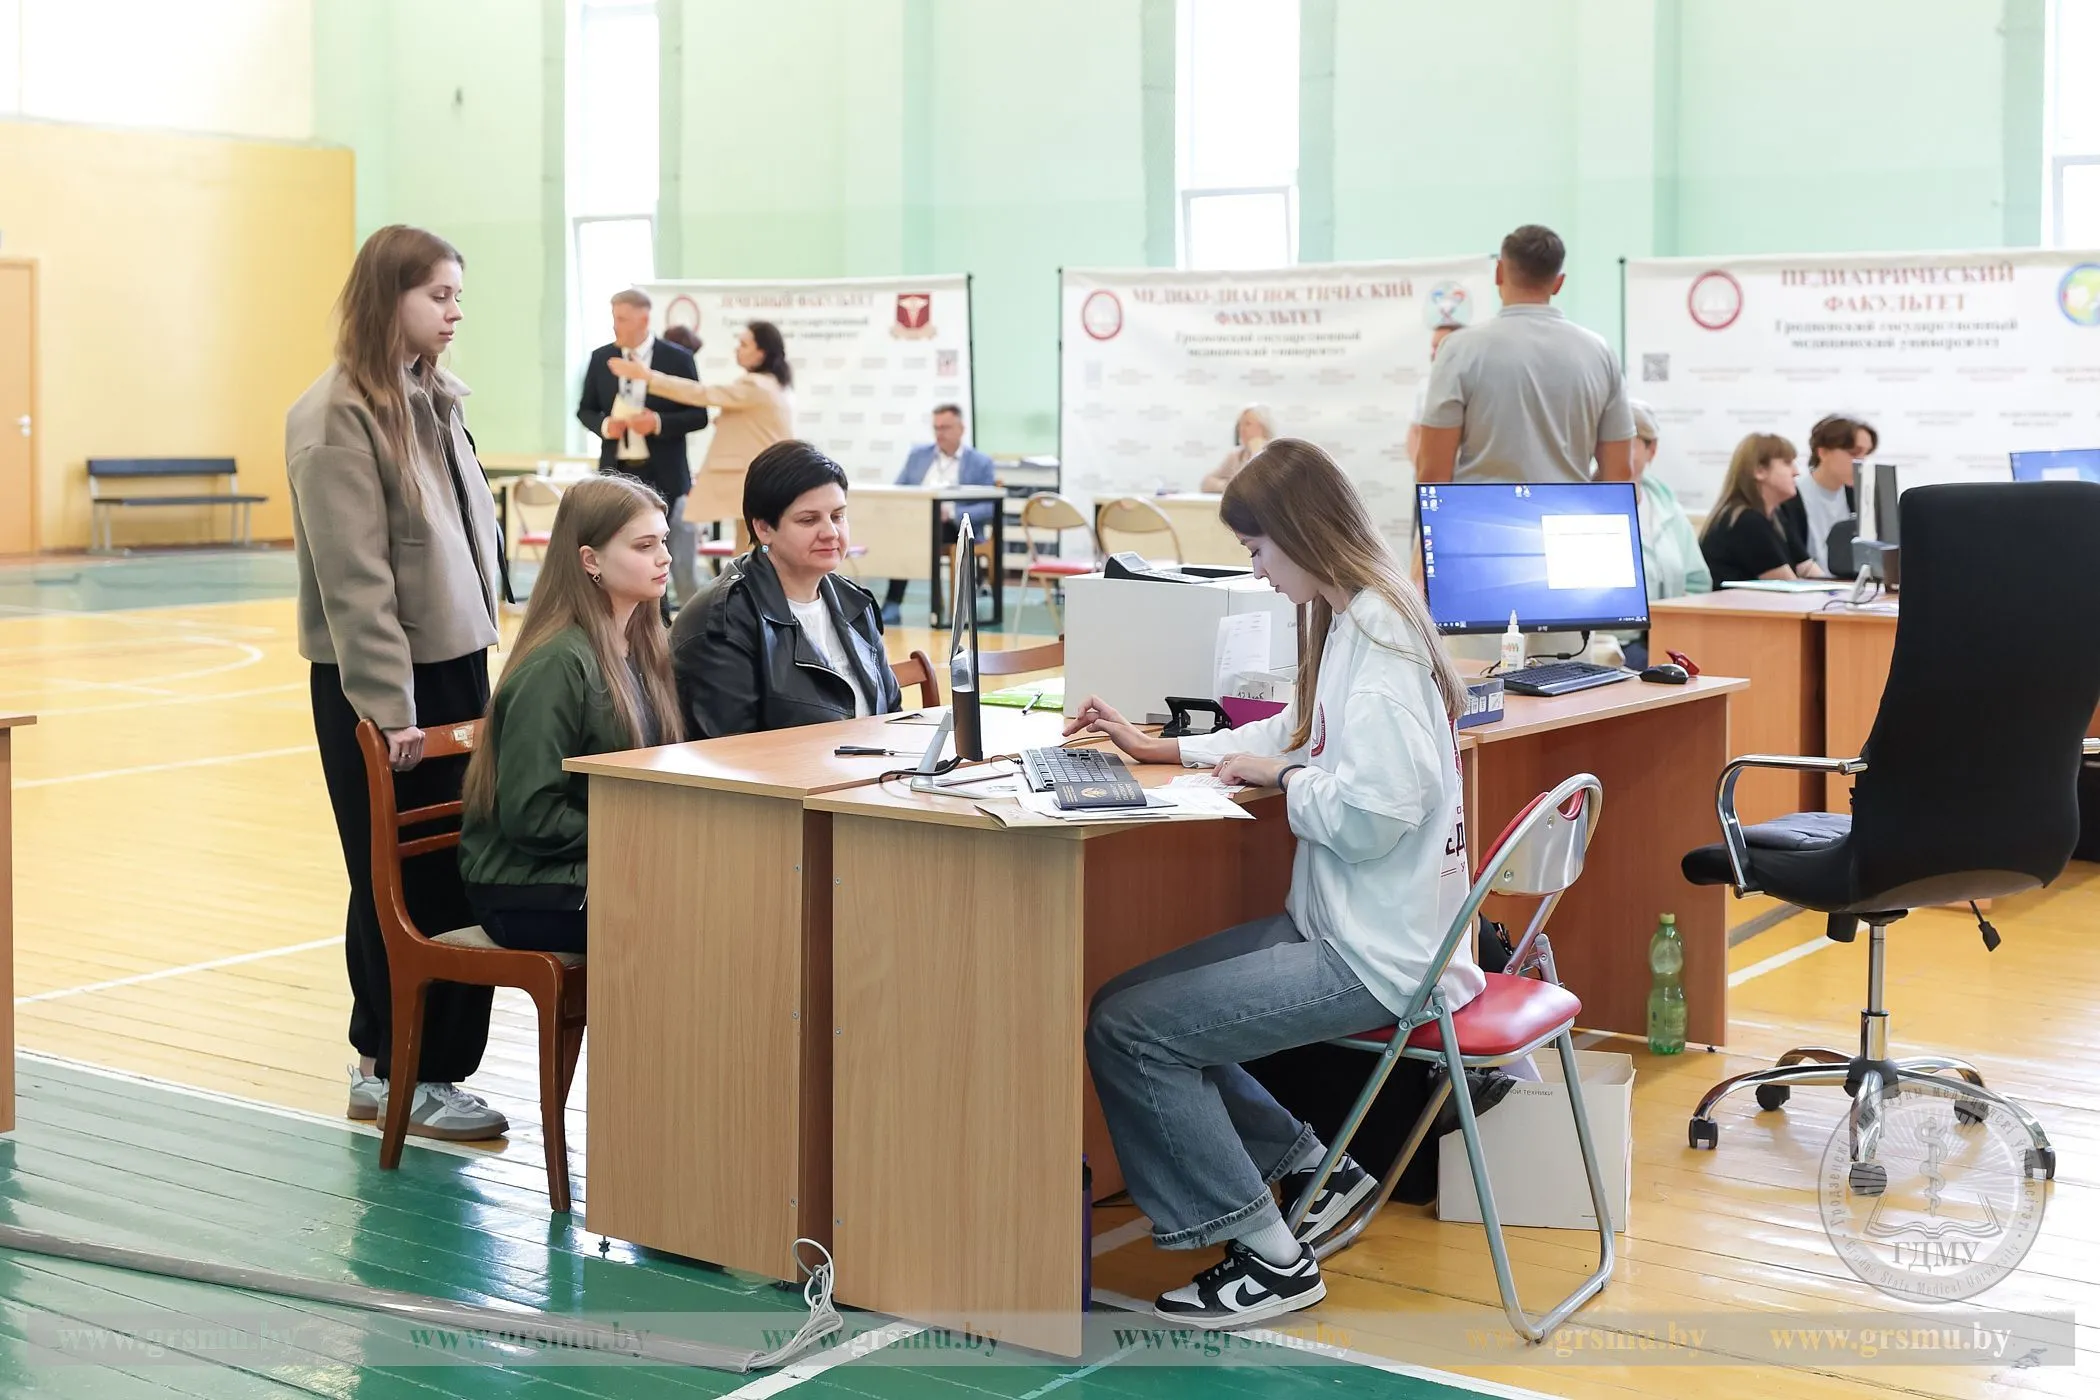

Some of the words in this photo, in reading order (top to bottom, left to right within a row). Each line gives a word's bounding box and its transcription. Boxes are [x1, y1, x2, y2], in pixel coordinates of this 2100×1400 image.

[1780, 264, 2015, 286] ПЕДИАТРИЧЕСКИЙ
[1824, 294, 1965, 312] ФАКУЛЬТЕТ
[1214, 309, 1323, 325] ФАКУЛЬТЕТ
